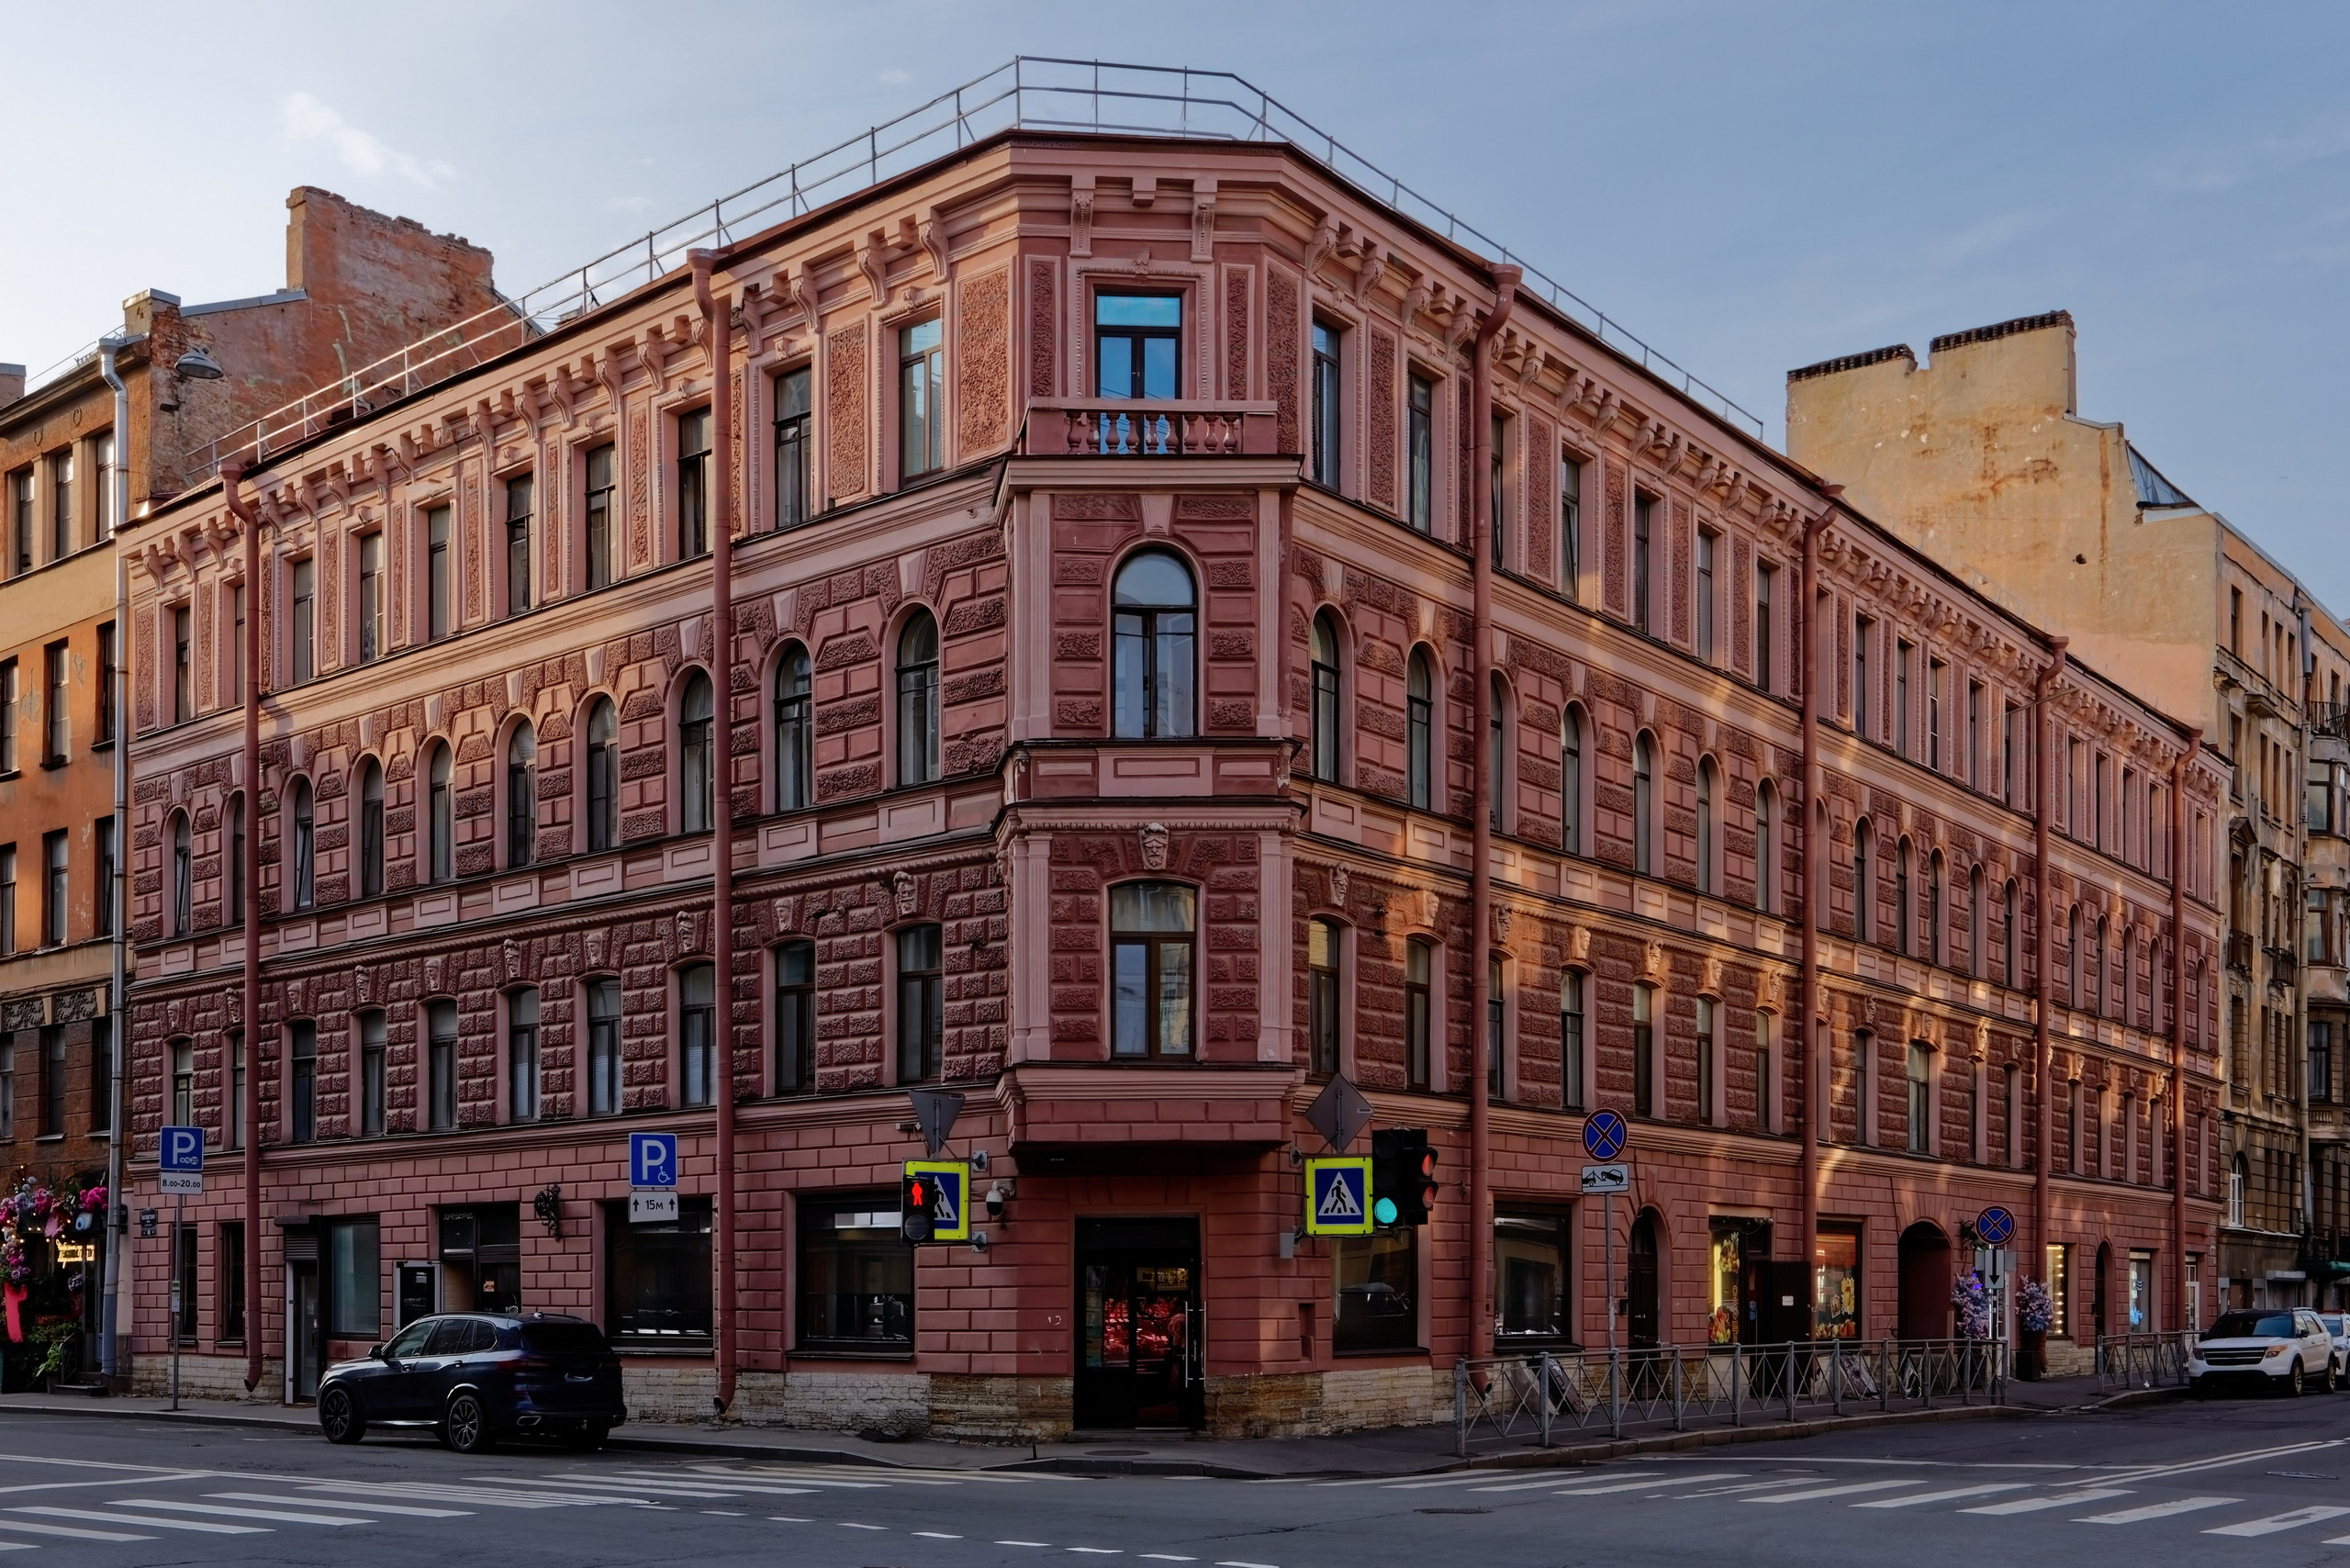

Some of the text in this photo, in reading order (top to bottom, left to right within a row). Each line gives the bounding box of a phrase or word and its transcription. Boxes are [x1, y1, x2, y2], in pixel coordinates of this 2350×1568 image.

[173, 1132, 196, 1165] P
[642, 1139, 666, 1181] P
[162, 1179, 201, 1188] 8.00-20.00
